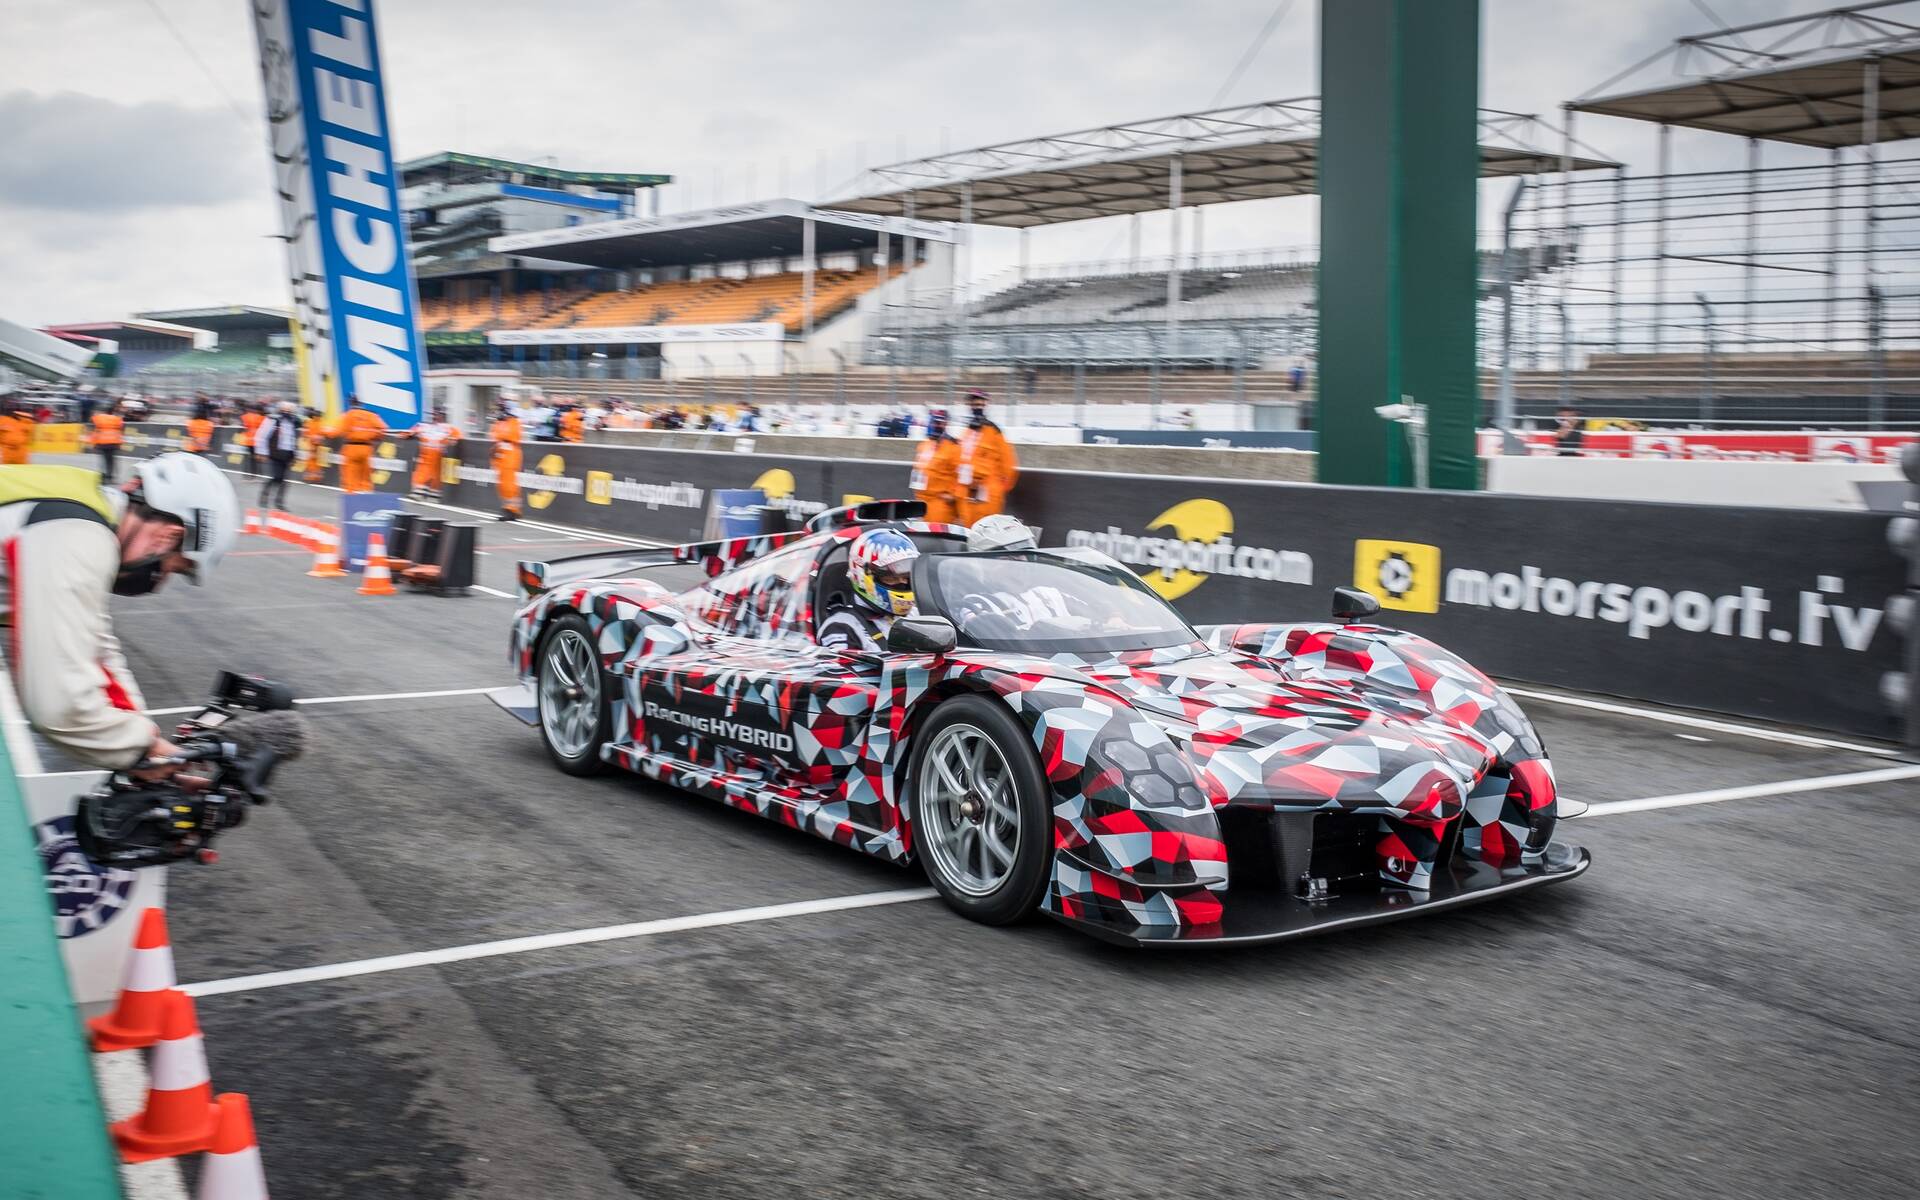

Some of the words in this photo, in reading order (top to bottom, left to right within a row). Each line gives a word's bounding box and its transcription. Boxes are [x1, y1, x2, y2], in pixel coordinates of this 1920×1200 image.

[307, 0, 417, 415] MICHEL
[1066, 526, 1313, 586] motorsport.com
[1445, 566, 1885, 652] motorsport.tv
